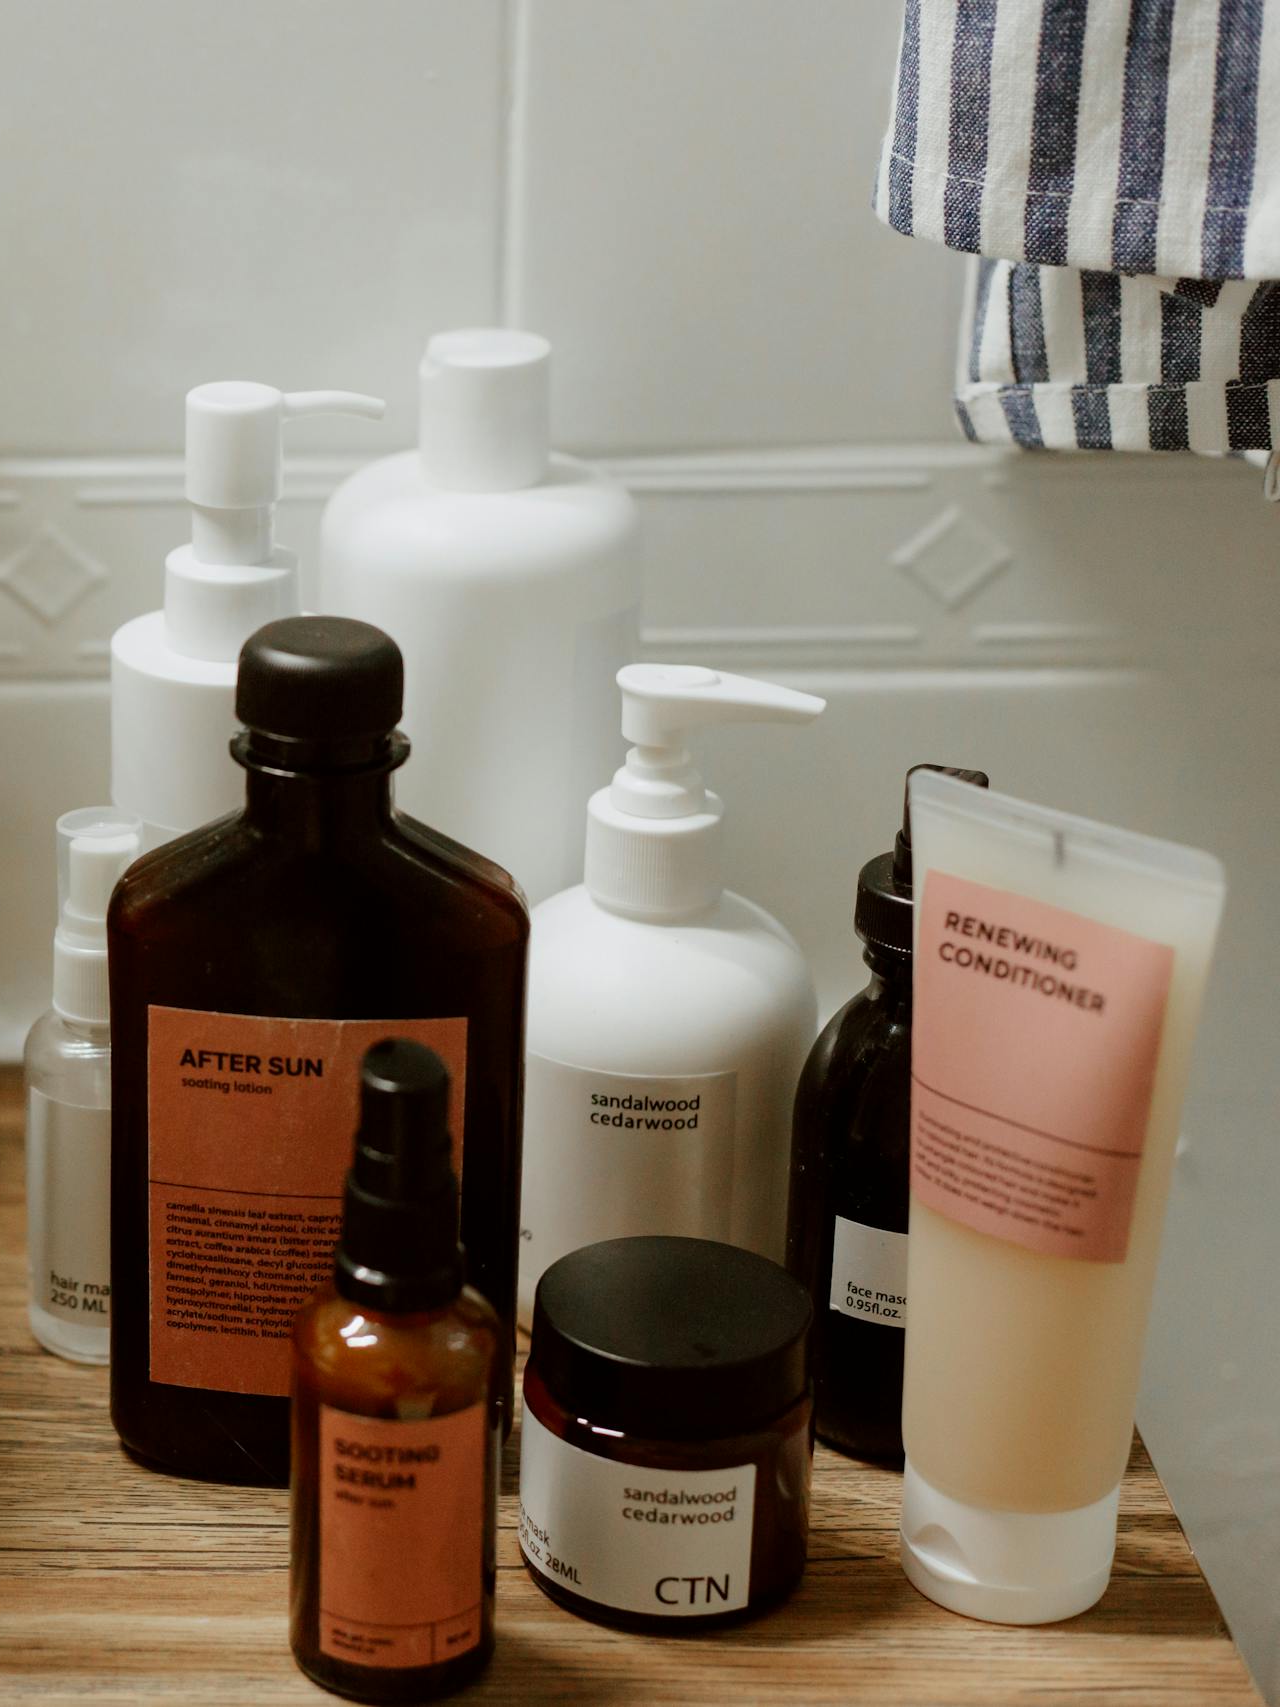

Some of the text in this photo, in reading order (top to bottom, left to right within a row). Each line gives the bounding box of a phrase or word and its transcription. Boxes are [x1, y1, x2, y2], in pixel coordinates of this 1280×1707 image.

[944, 911, 1078, 972] RENEWING
[938, 942, 1107, 1013] CONDITIONER
[180, 1049, 323, 1078] AFTER SUN
[233, 1080, 272, 1095] lotion
[591, 1093, 700, 1112] sandalwood
[590, 1112, 699, 1131] cedarwood
[166, 1203, 205, 1213] camellia
[247, 1210, 266, 1218] leaf
[166, 1225, 192, 1235] citrus
[50, 1270, 78, 1291] hair
[847, 1281, 872, 1298] face
[50, 1288, 108, 1314] 250 ML
[846, 1296, 901, 1319] 0.95fl.oz.
[623, 1486, 737, 1506] sandalwood
[621, 1506, 735, 1525] cedarwood
[526, 1515, 550, 1547] mask
[545, 1553, 582, 1585] 28ML
[654, 1573, 730, 1605] CTN
